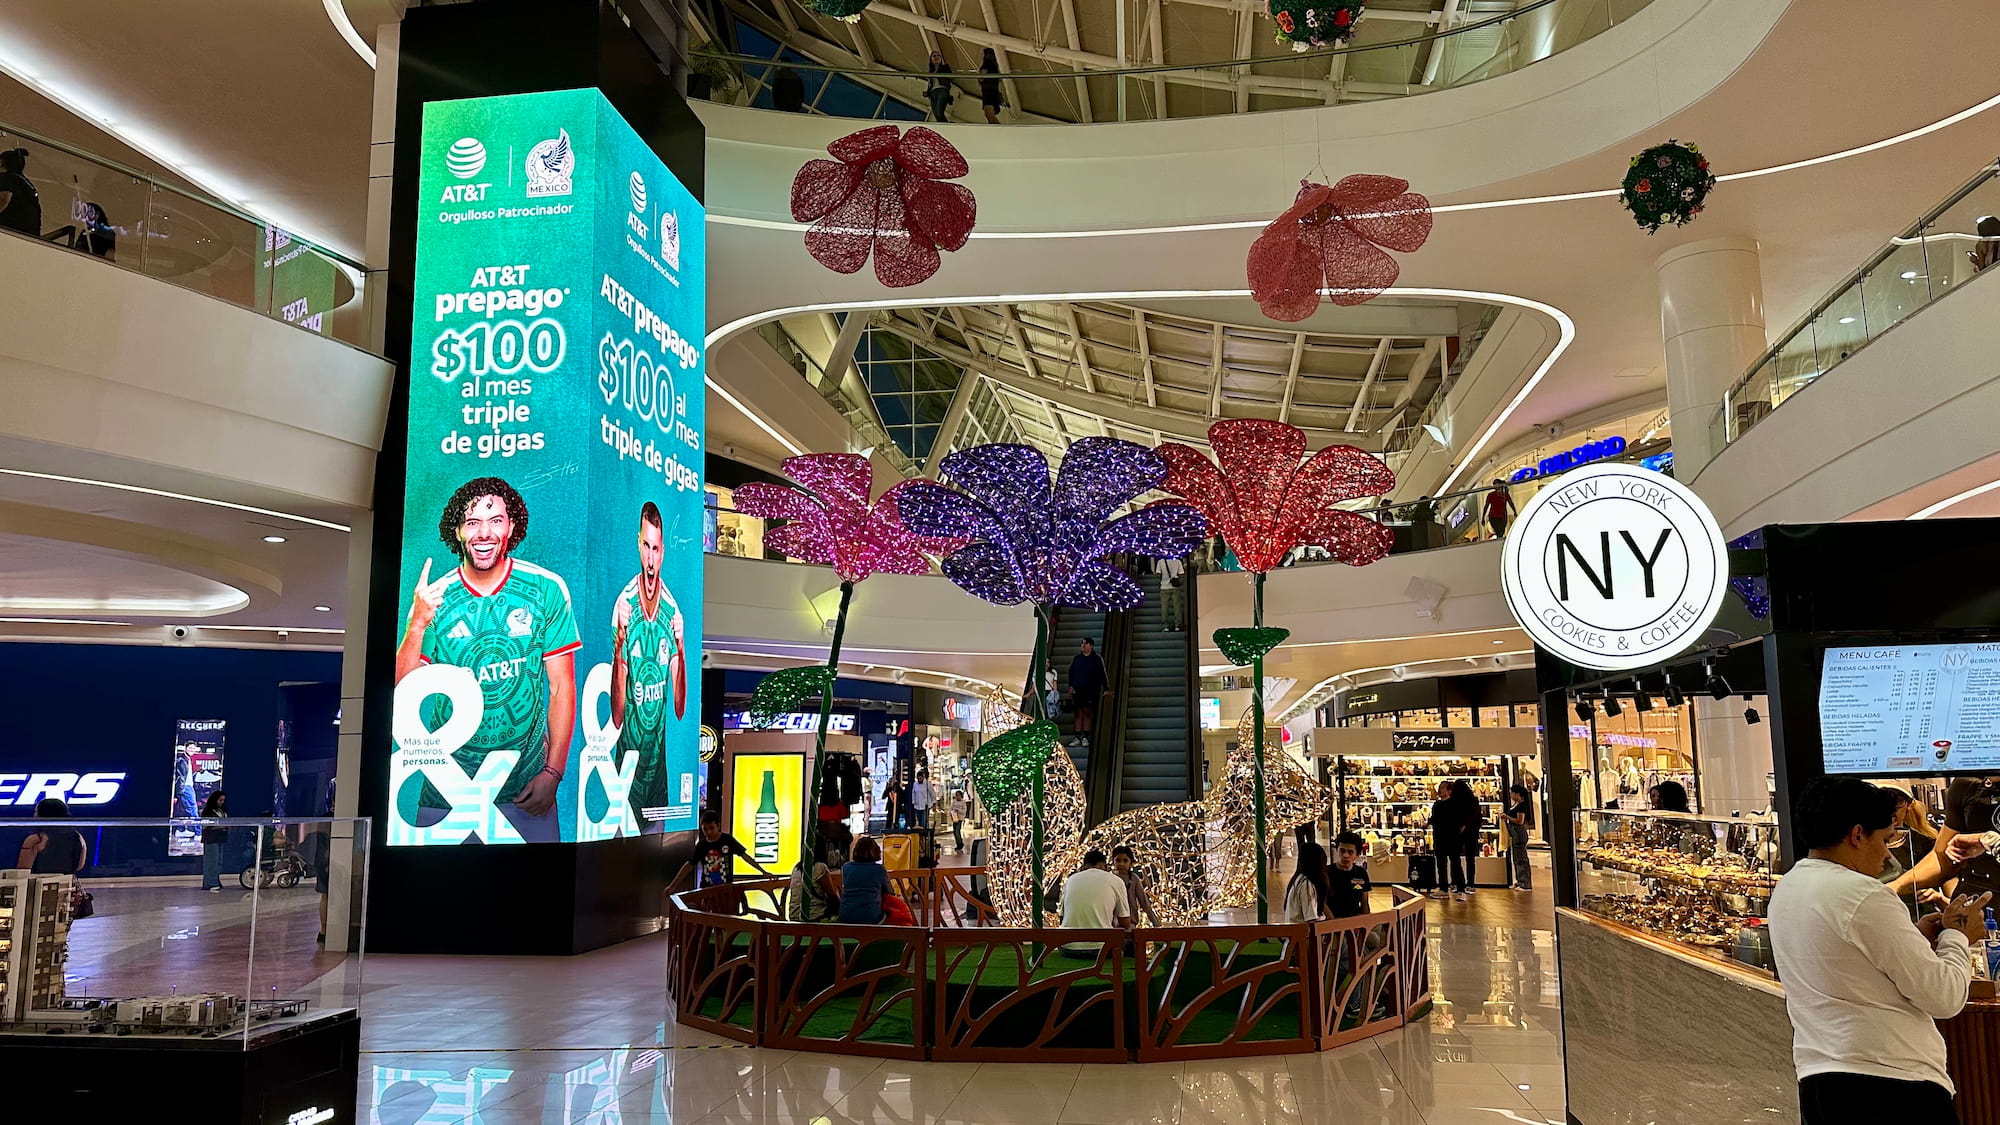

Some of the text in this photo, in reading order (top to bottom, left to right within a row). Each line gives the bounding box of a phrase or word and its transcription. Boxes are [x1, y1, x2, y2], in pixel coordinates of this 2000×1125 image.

[440, 183, 492, 204] AT&T
[530, 183, 568, 194] MEXICO
[439, 203, 574, 224] Orgulloso Patrocinador
[627, 211, 649, 240] AT&T
[471, 265, 530, 288] AT&T
[435, 286, 565, 321] prepago
[601, 273, 699, 369] AT&T prepago
[431, 318, 567, 382] $100
[461, 376, 532, 398] al mes
[599, 332, 686, 433] $100 al
[462, 401, 530, 428] triple
[441, 428, 545, 458] de gigas
[675, 420, 699, 451] mes
[601, 414, 699, 493] triple de gigas
[1549, 480, 1673, 514] NEW YORK
[1556, 528, 1672, 601] NY
[1542, 601, 1698, 650] COOKIES & COFFEE
[1839, 651, 1871, 659] MENU
[1943, 653, 1969, 667] NY
[479, 657, 526, 684] AT&T
[644, 680, 666, 702] AT&T
[739, 711, 855, 731] SECHRS
[424, 738, 440, 747] que
[403, 758, 449, 767] personas.
[0, 773, 126, 805] ERS
